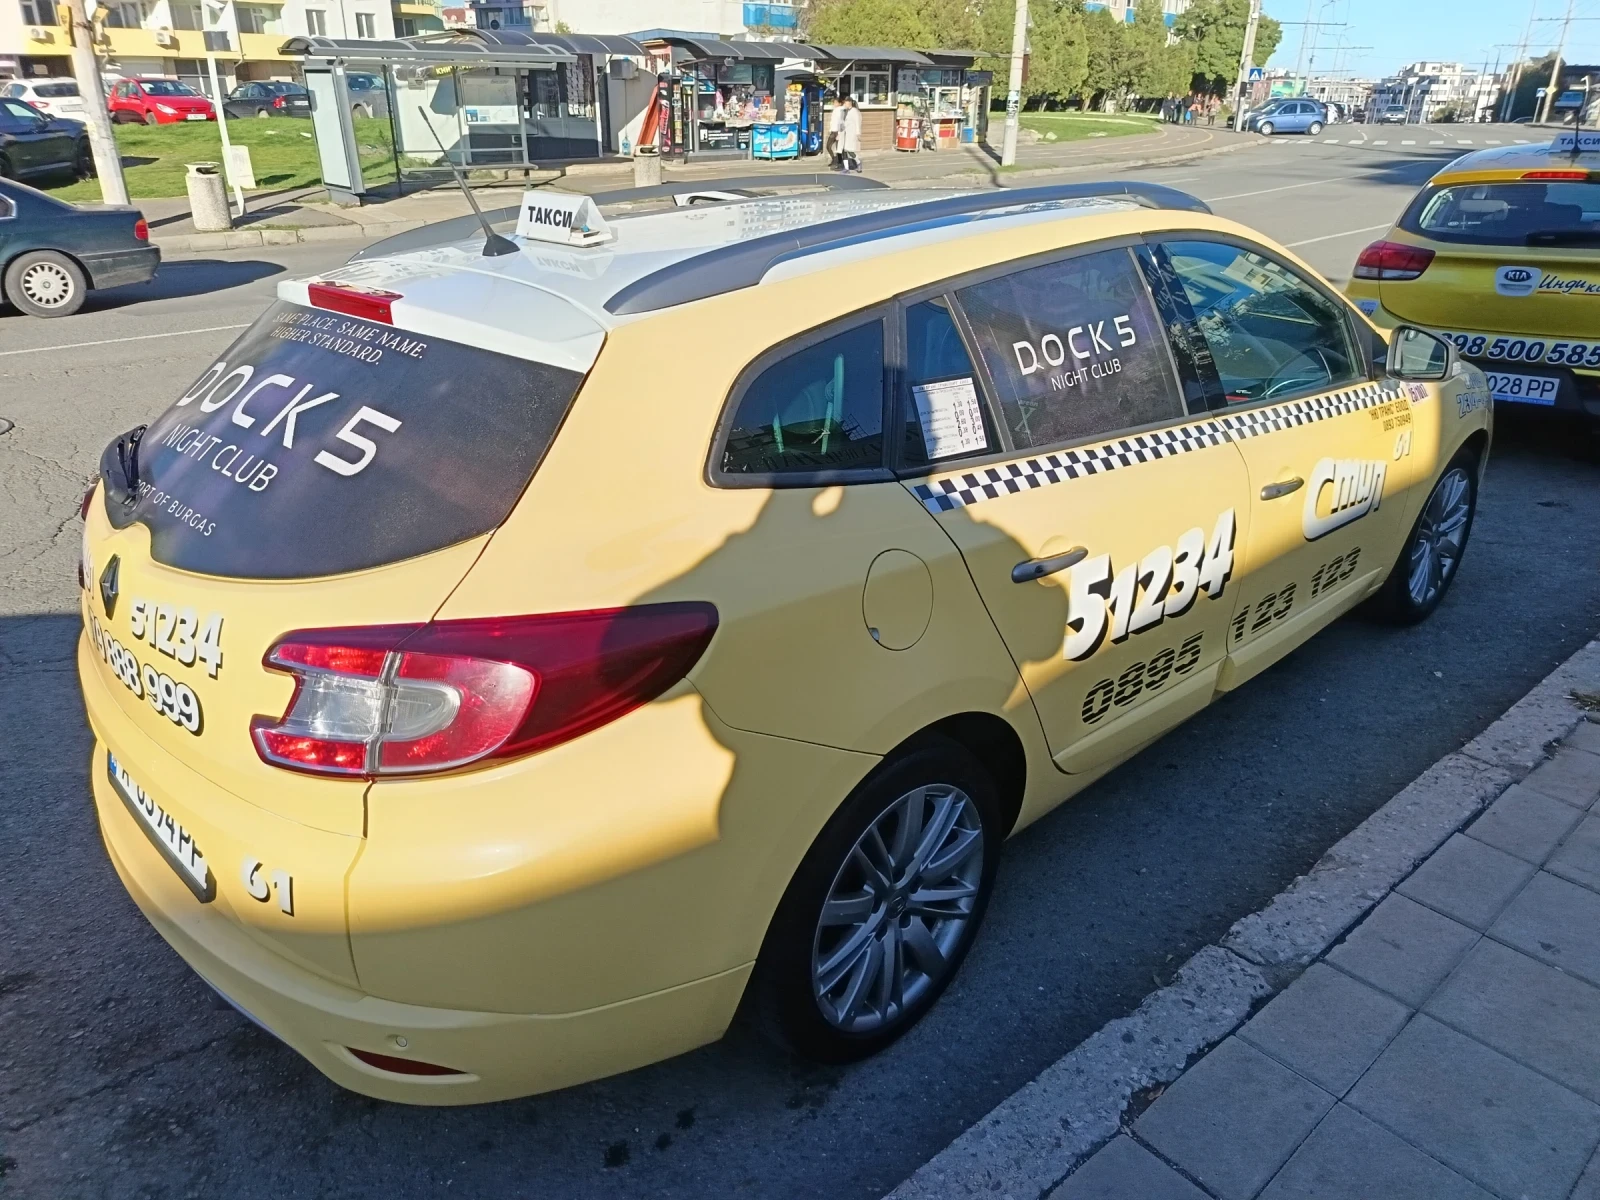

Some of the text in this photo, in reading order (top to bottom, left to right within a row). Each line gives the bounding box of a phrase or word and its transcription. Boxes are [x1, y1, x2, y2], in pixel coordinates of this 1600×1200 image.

[528, 206, 573, 229] ТАКСИ
[1507, 271, 1528, 280] KIA
[270, 326, 384, 365] HIGHER STANDARD.
[273, 312, 428, 359] SAME PLACE. SAME NAME.
[1012, 315, 1136, 376] DOCK 5
[1487, 338, 1545, 362] 500
[1545, 343, 1600, 367] 585
[1051, 358, 1122, 391] NIGHT CLUB
[1526, 379, 1555, 398] PP
[176, 361, 402, 477] DOCK 5
[162, 422, 279, 492] NIGHT CLUB
[153, 492, 171, 506] OF
[167, 500, 216, 536] BURGAS
[1063, 506, 1236, 662] 51234
[131, 598, 224, 680] 51234
[1081, 629, 1204, 725] 0895
[1311, 546, 1361, 599] 123
[143, 663, 204, 736] 999
[241, 859, 294, 916] 61
